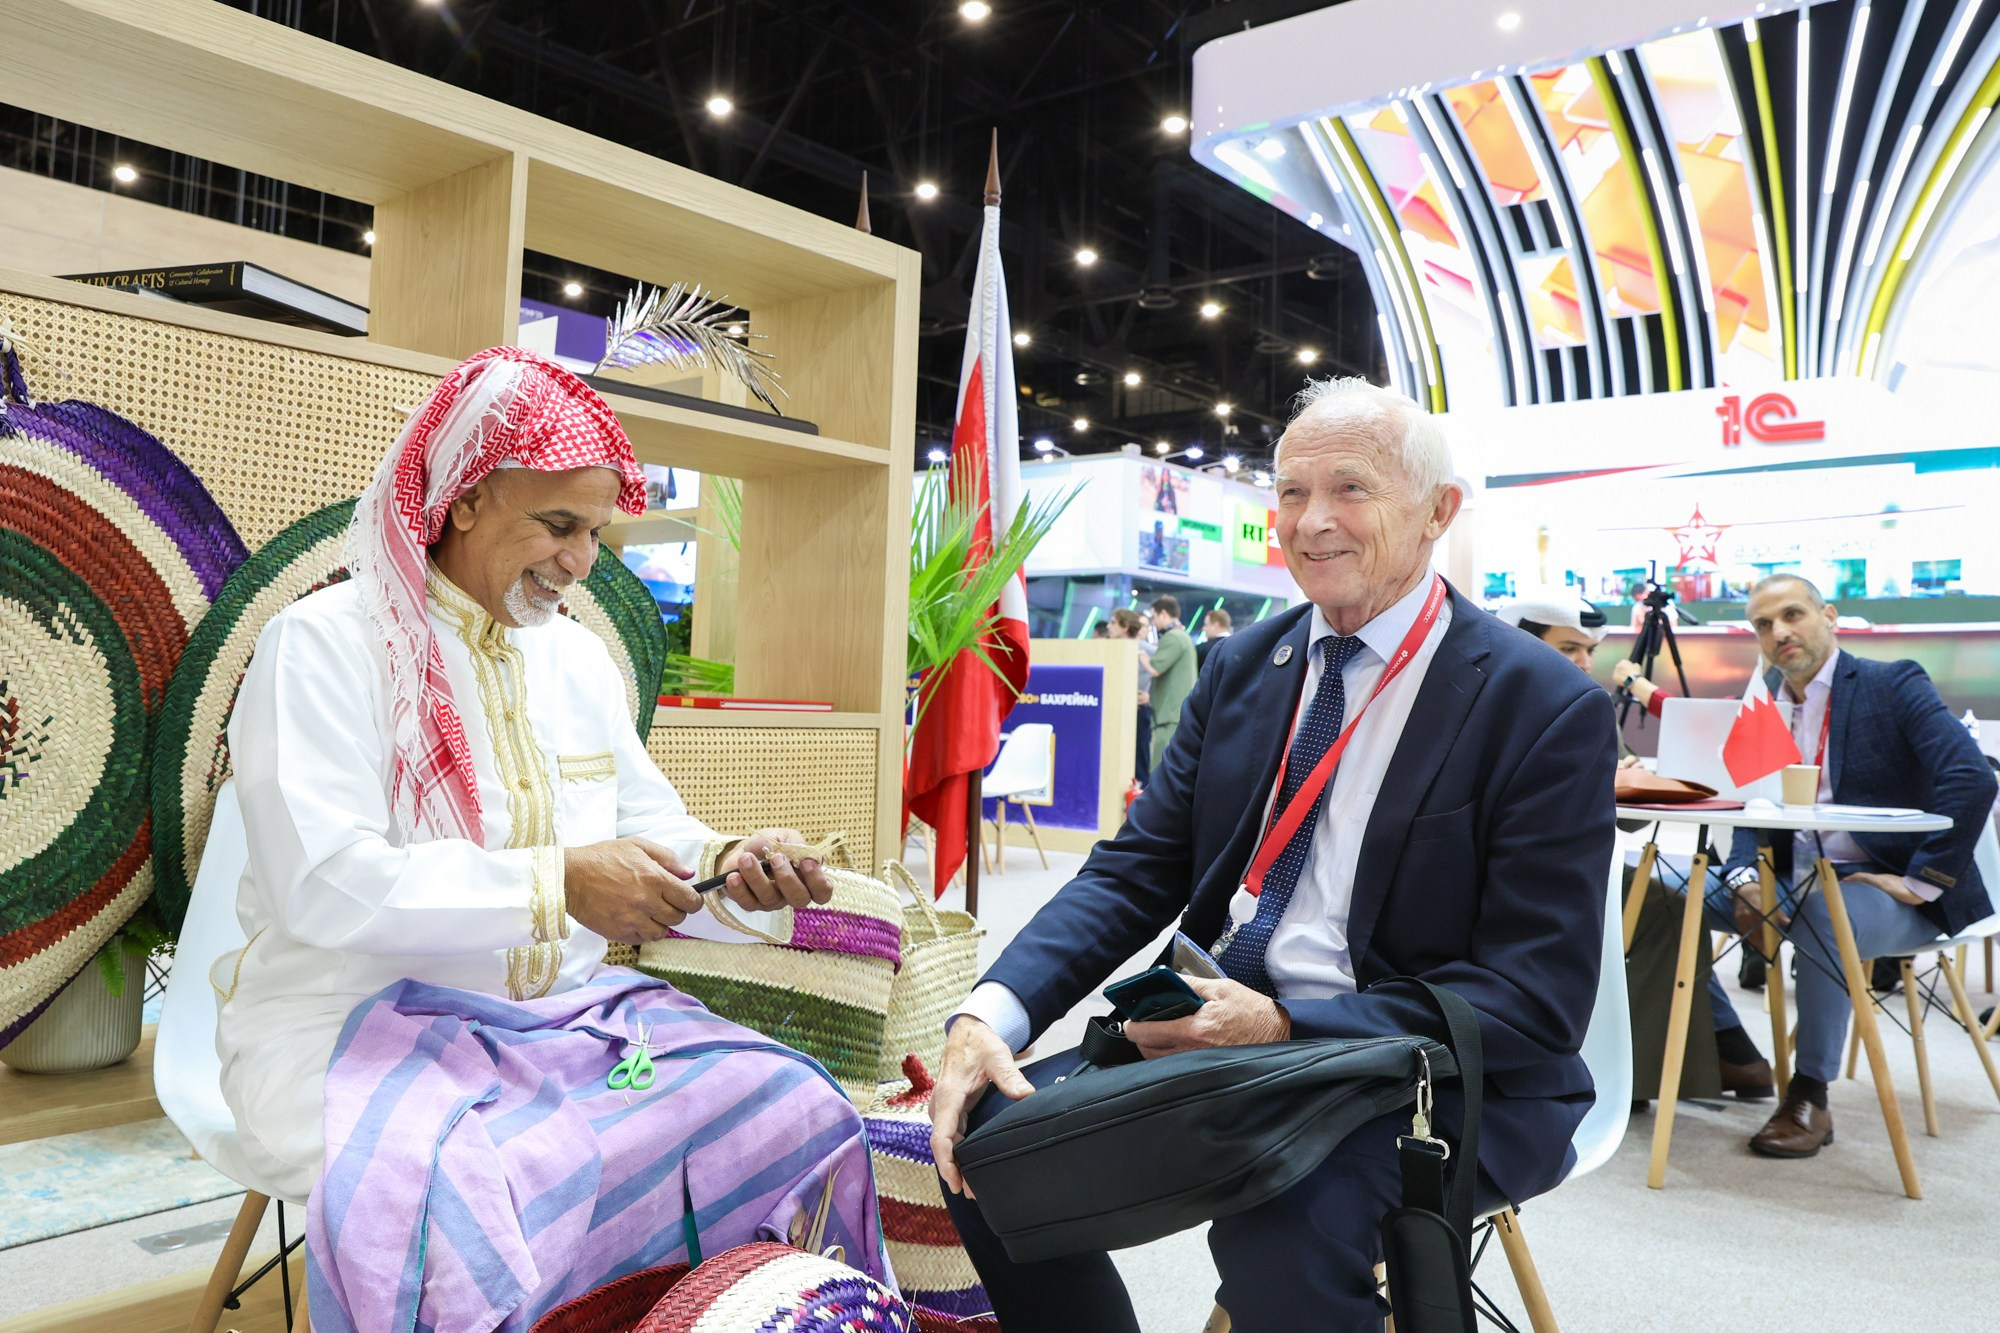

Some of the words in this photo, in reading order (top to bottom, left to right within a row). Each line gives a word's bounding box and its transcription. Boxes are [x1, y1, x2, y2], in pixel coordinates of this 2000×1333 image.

[112, 271, 166, 289] CRAFTS
[1243, 524, 1264, 542] RT
[1040, 691, 1099, 707] БАХРЕЙНА:
